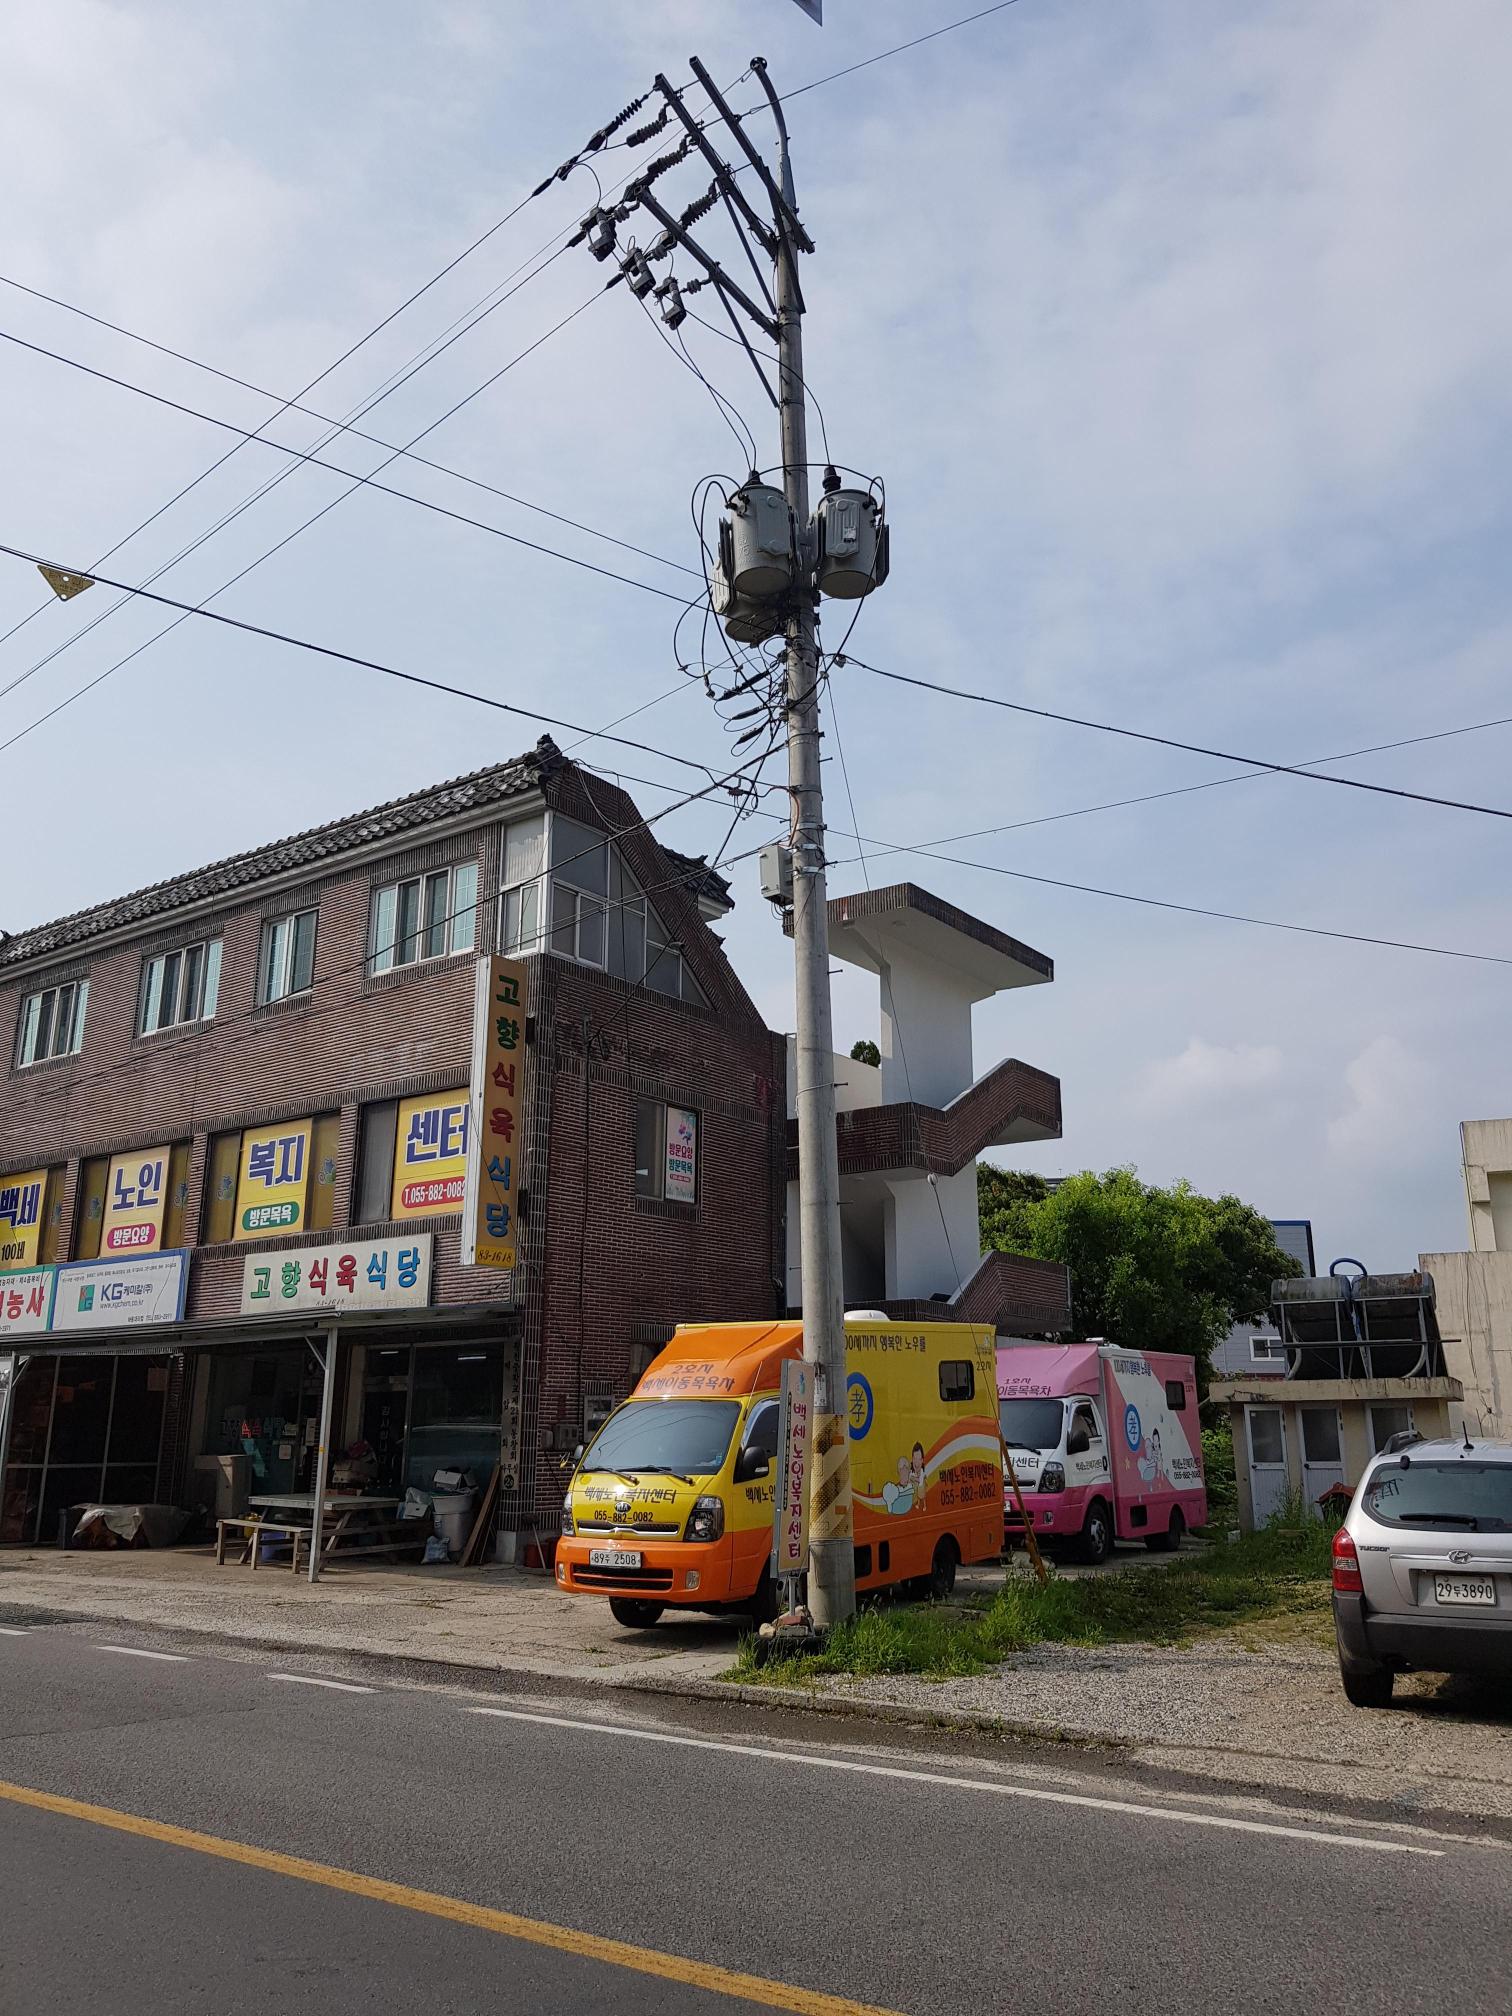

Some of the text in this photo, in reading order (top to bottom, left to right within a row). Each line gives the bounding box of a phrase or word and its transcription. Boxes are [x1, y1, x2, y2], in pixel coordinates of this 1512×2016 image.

[487, 974, 520, 1238] 고향식육식당
[406, 1104, 469, 1164] 센터
[249, 1134, 305, 1187] 복지
[669, 1142, 693, 1159] 방문요양
[669, 1159, 693, 1174] 방문목욕
[112, 1161, 162, 1211] 노인
[404, 1178, 465, 1205] T.055-882-0082
[0, 1183, 41, 1227] 백세
[249, 1203, 292, 1227] 방문목욕
[113, 1226, 149, 1246] 방문요양
[2, 1241, 26, 1261] 100세
[478, 1249, 512, 1262] 83-1618
[250, 1247, 420, 1299] 고향식육식당
[998, 1385, 1051, 1396] 이동목욕차
[849, 1388, 866, 1423] 孝
[788, 1402, 806, 1559] 백세노인복지센터
[940, 1483, 996, 1506] 055-882-0082
[594, 1510, 654, 1523] 055-882-0082
[614, 1553, 637, 1566] 2508
